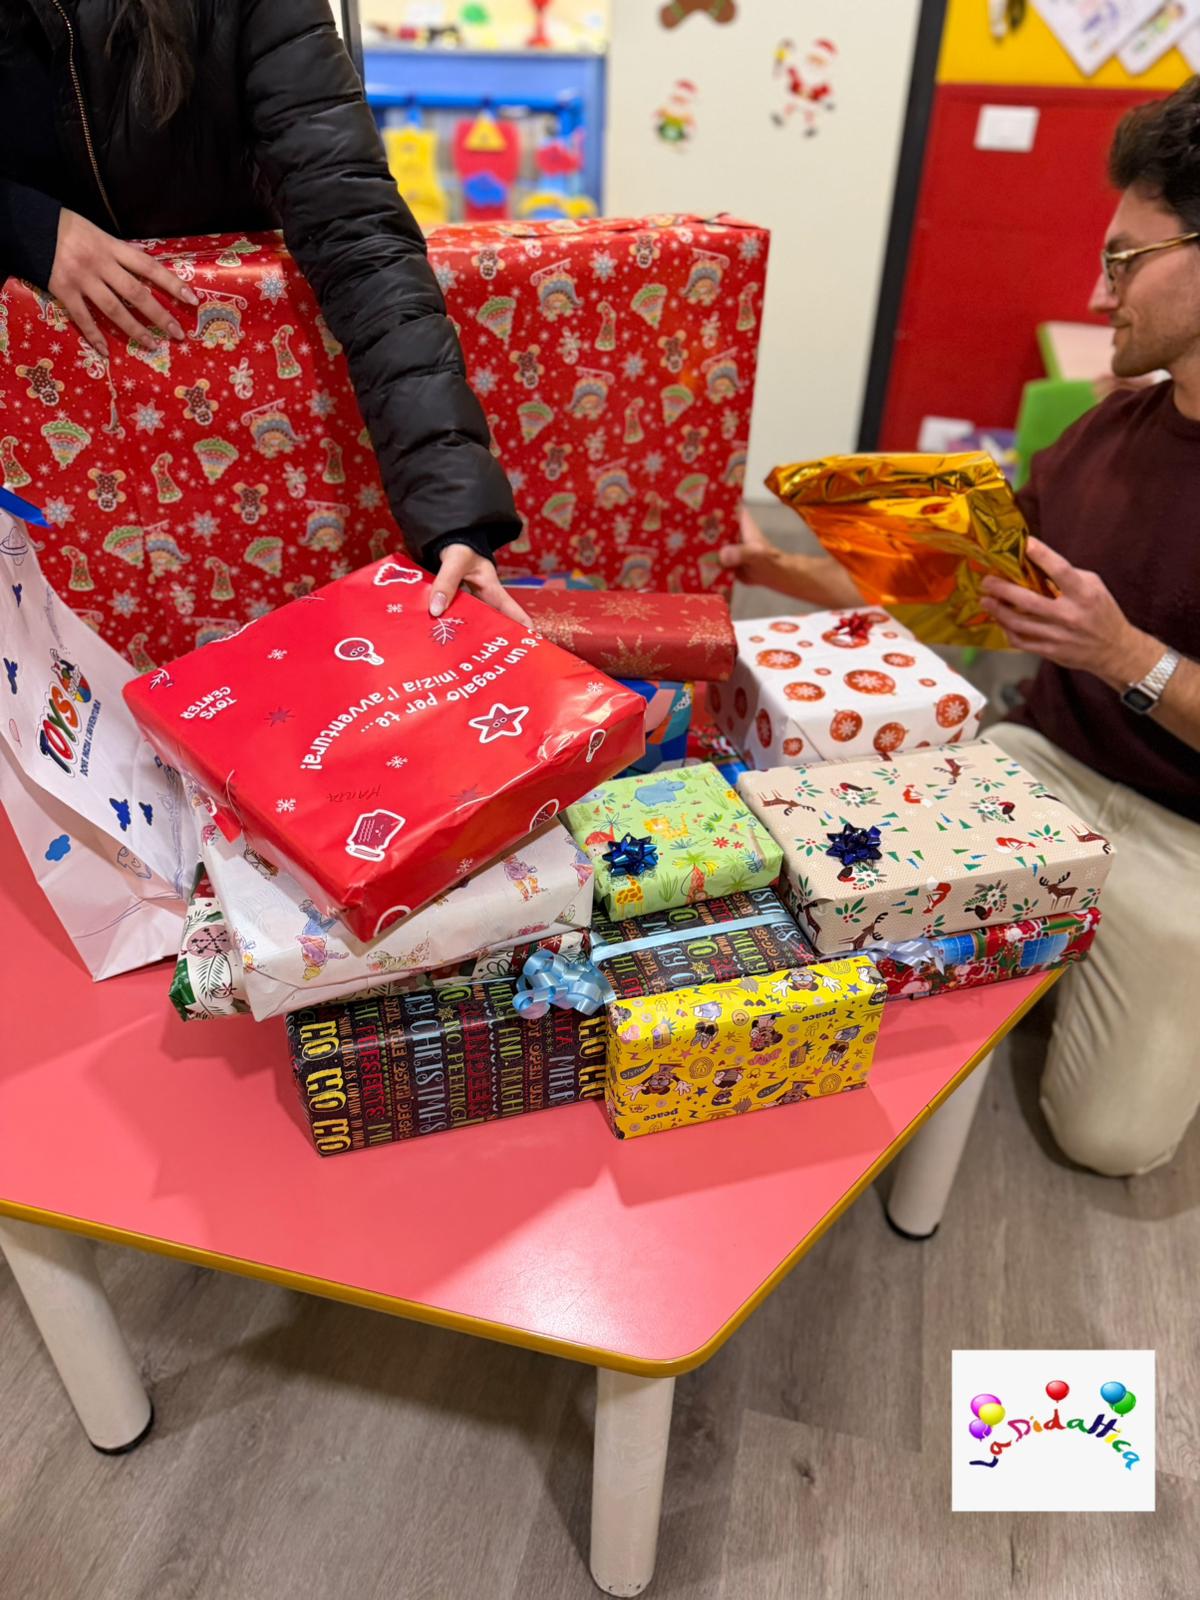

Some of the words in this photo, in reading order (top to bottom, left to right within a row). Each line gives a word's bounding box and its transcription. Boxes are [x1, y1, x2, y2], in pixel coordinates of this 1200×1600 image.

[472, 637, 509, 663] Apri
[504, 648, 528, 664] un
[402, 670, 460, 692] inizia
[446, 665, 506, 701] regalo
[459, 662, 474, 672] e
[180, 686, 231, 719] CENTER
[200, 697, 237, 720] TOYS
[404, 692, 438, 714] per
[40, 686, 79, 774] TOYS
[360, 711, 401, 733] te...
[728, 930, 769, 974] MERRY
[802, 1007, 836, 1022] peace
[300, 1021, 340, 1061] HO
[444, 1020, 462, 1045] NO
[498, 1027, 522, 1061] AND
[579, 1016, 608, 1060] HO
[355, 1026, 385, 1120] PRESENTS
[409, 1019, 449, 1134] CHRISTMAS
[529, 1042, 544, 1080] OPEN
[306, 1067, 347, 1112] HO
[643, 1108, 678, 1121] peace
[312, 1118, 352, 1155] HO
